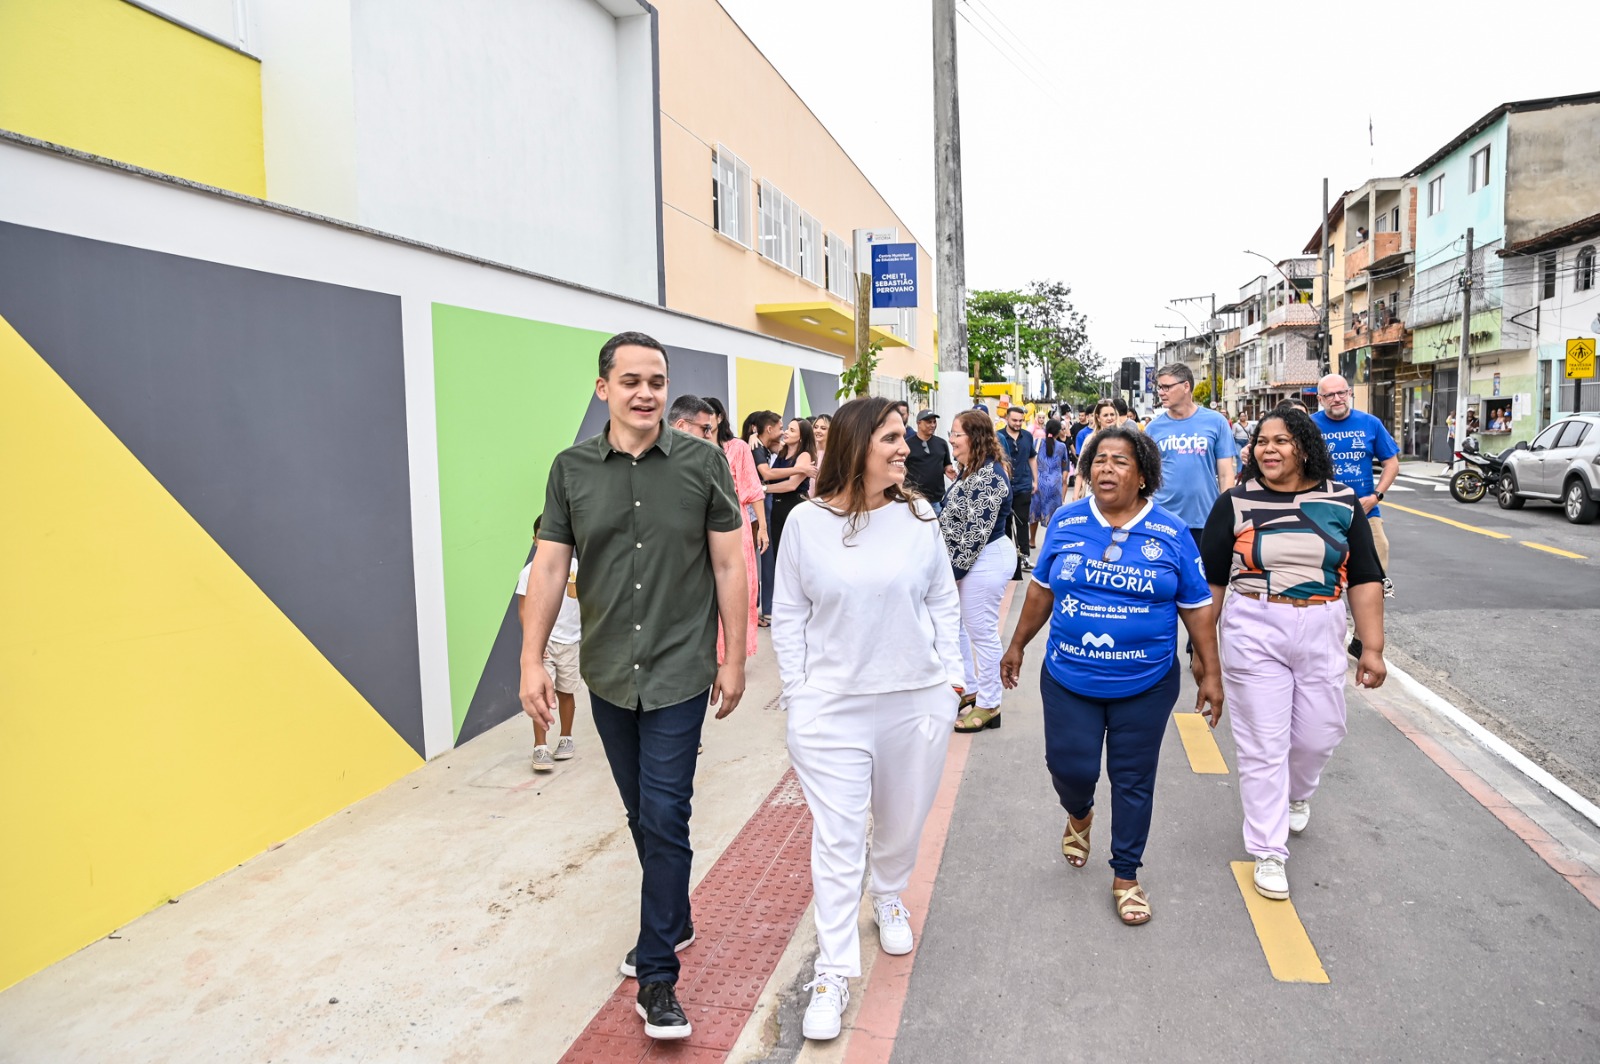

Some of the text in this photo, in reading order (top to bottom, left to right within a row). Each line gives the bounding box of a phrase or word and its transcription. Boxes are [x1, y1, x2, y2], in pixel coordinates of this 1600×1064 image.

[875, 279, 914, 287] SEBASTIÃO
[1159, 433, 1208, 452] vitória
[1331, 451, 1366, 461] congo
[1086, 558, 1157, 579] PREFEITURA DE
[1085, 568, 1155, 594] VITÓRIA
[1080, 603, 1106, 612] Cruzeiro
[1059, 641, 1148, 660] MARCA AMBIENTAL
